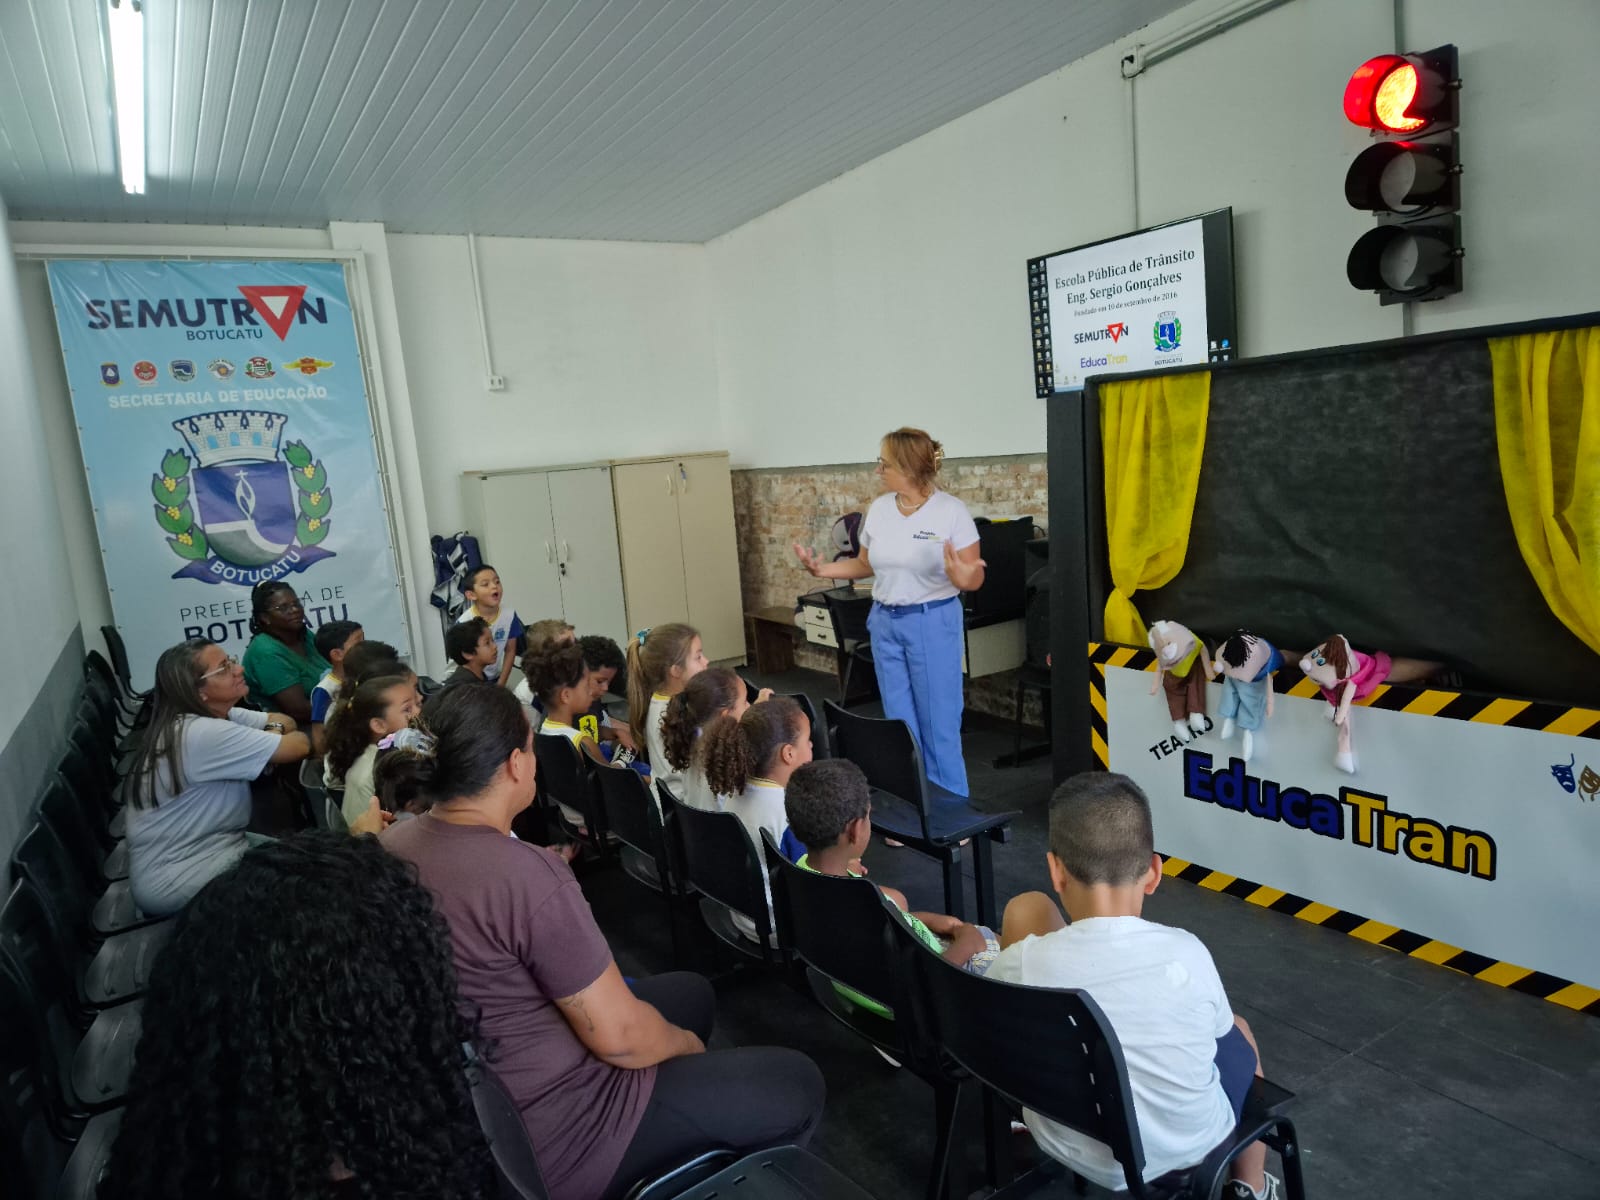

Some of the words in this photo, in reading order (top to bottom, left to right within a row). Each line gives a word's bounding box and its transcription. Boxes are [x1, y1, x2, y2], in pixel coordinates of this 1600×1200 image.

[1055, 273, 1085, 289] Escola
[1088, 264, 1126, 282] Pública
[1129, 260, 1143, 273] de
[1145, 250, 1195, 269] Trânsito
[1066, 292, 1088, 305] Eng.
[1090, 284, 1122, 299] Sergio
[1125, 273, 1182, 292] Gonçalves
[1161, 292, 1178, 301] 2016
[186, 328, 263, 341] BOTUCATU
[109, 390, 214, 408] SECRETARIA
[218, 390, 240, 403] DE
[243, 384, 328, 402] EDUCAÇÃO
[210, 550, 301, 583] BOTUCATU
[180, 590, 313, 622] PREFEA
[321, 585, 345, 601] DE
[1183, 749, 1497, 881] EducaTran
